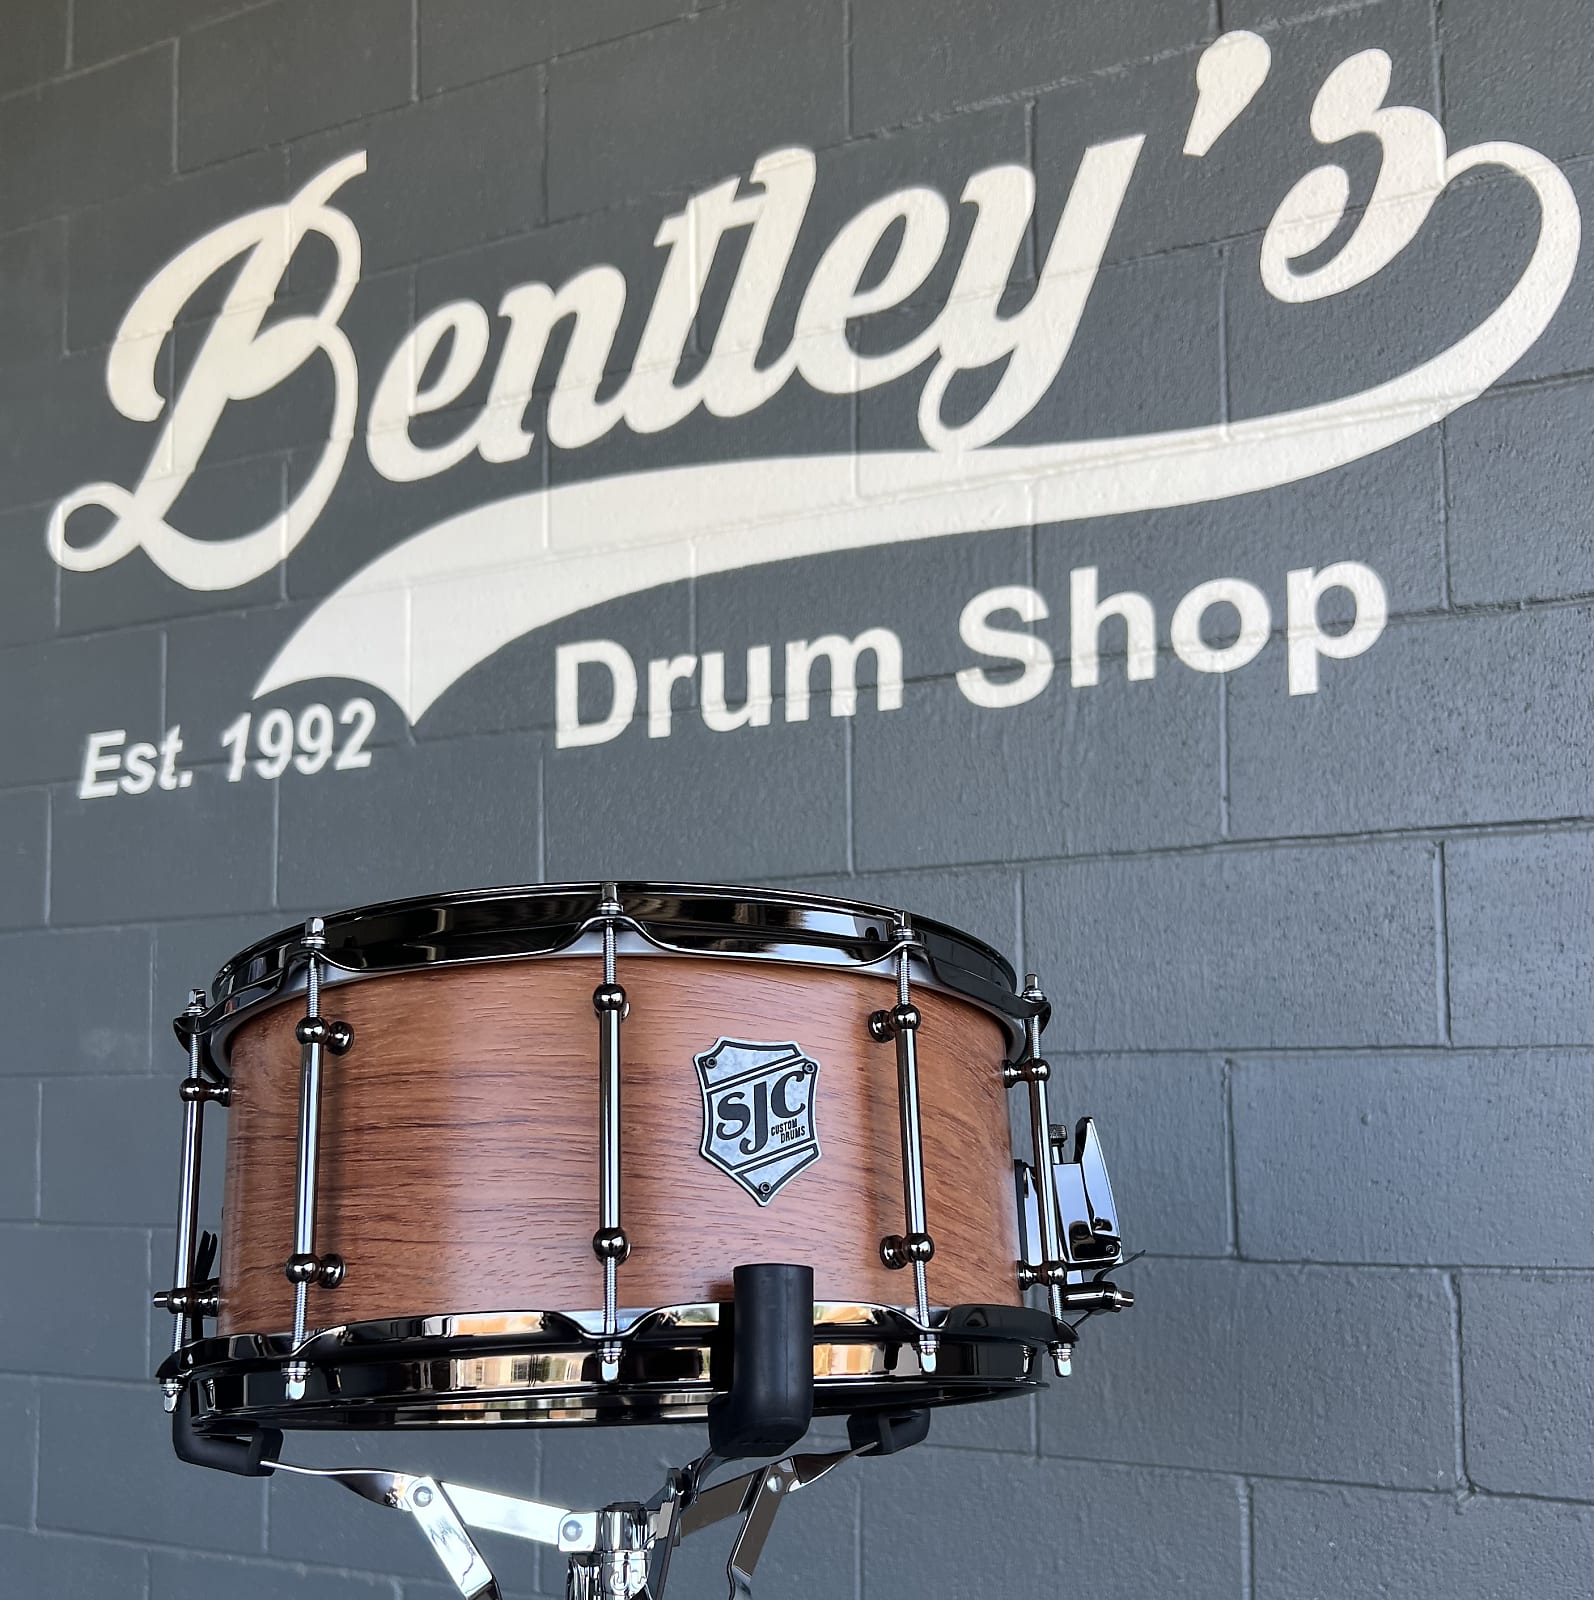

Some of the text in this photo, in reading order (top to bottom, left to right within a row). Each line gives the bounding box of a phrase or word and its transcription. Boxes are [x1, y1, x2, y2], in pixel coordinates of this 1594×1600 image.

[46, 29, 1582, 592] Bentley's
[555, 560, 1389, 749] Drum Shop
[79, 697, 376, 800] Est. 1992
[716, 1070, 806, 1155] SJC
[771, 1118, 798, 1136] CUSTOM
[781, 1126, 806, 1143] DRUMS
